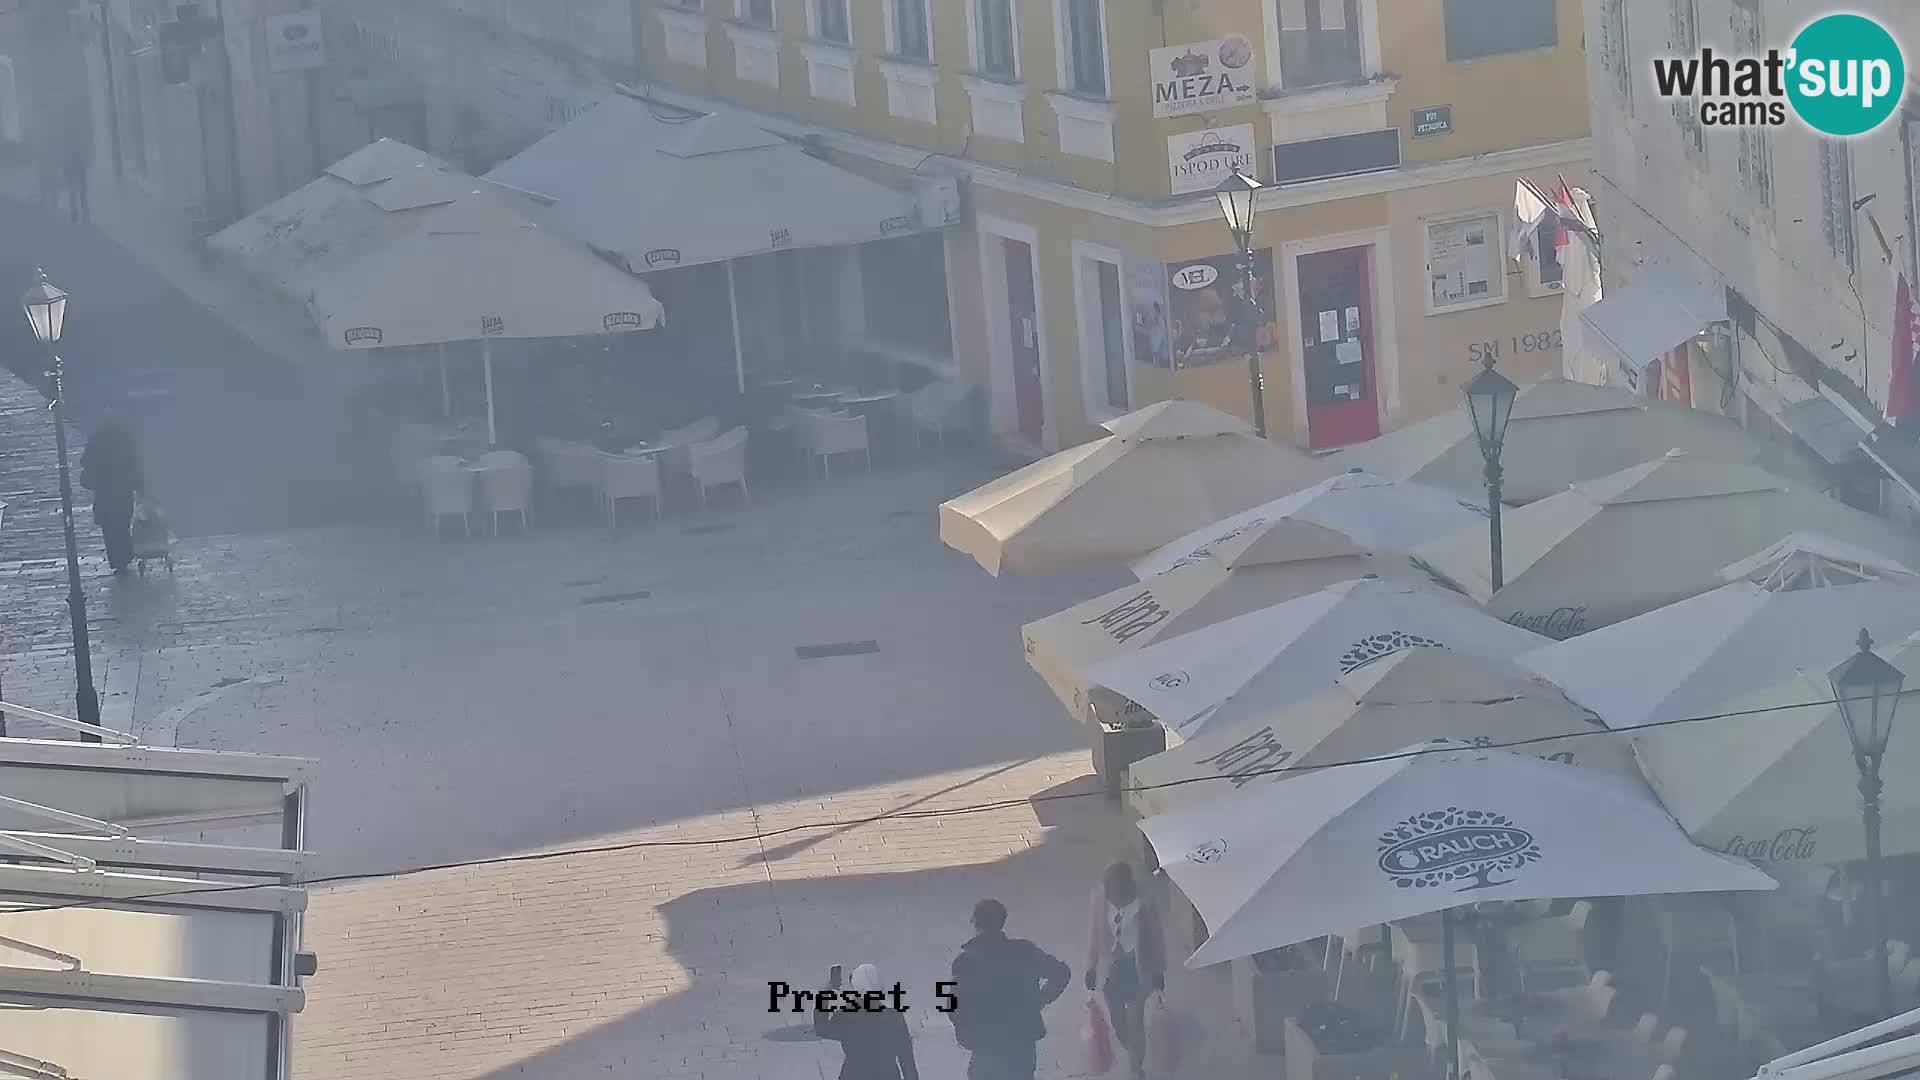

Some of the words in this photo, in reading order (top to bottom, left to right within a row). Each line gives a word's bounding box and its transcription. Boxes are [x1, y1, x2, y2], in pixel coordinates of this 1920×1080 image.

[1156, 73, 1234, 103] MEZA
[1174, 159, 1220, 177] ISPOD
[1512, 328, 1564, 354] 1982
[1418, 832, 1515, 862] RAUCH
